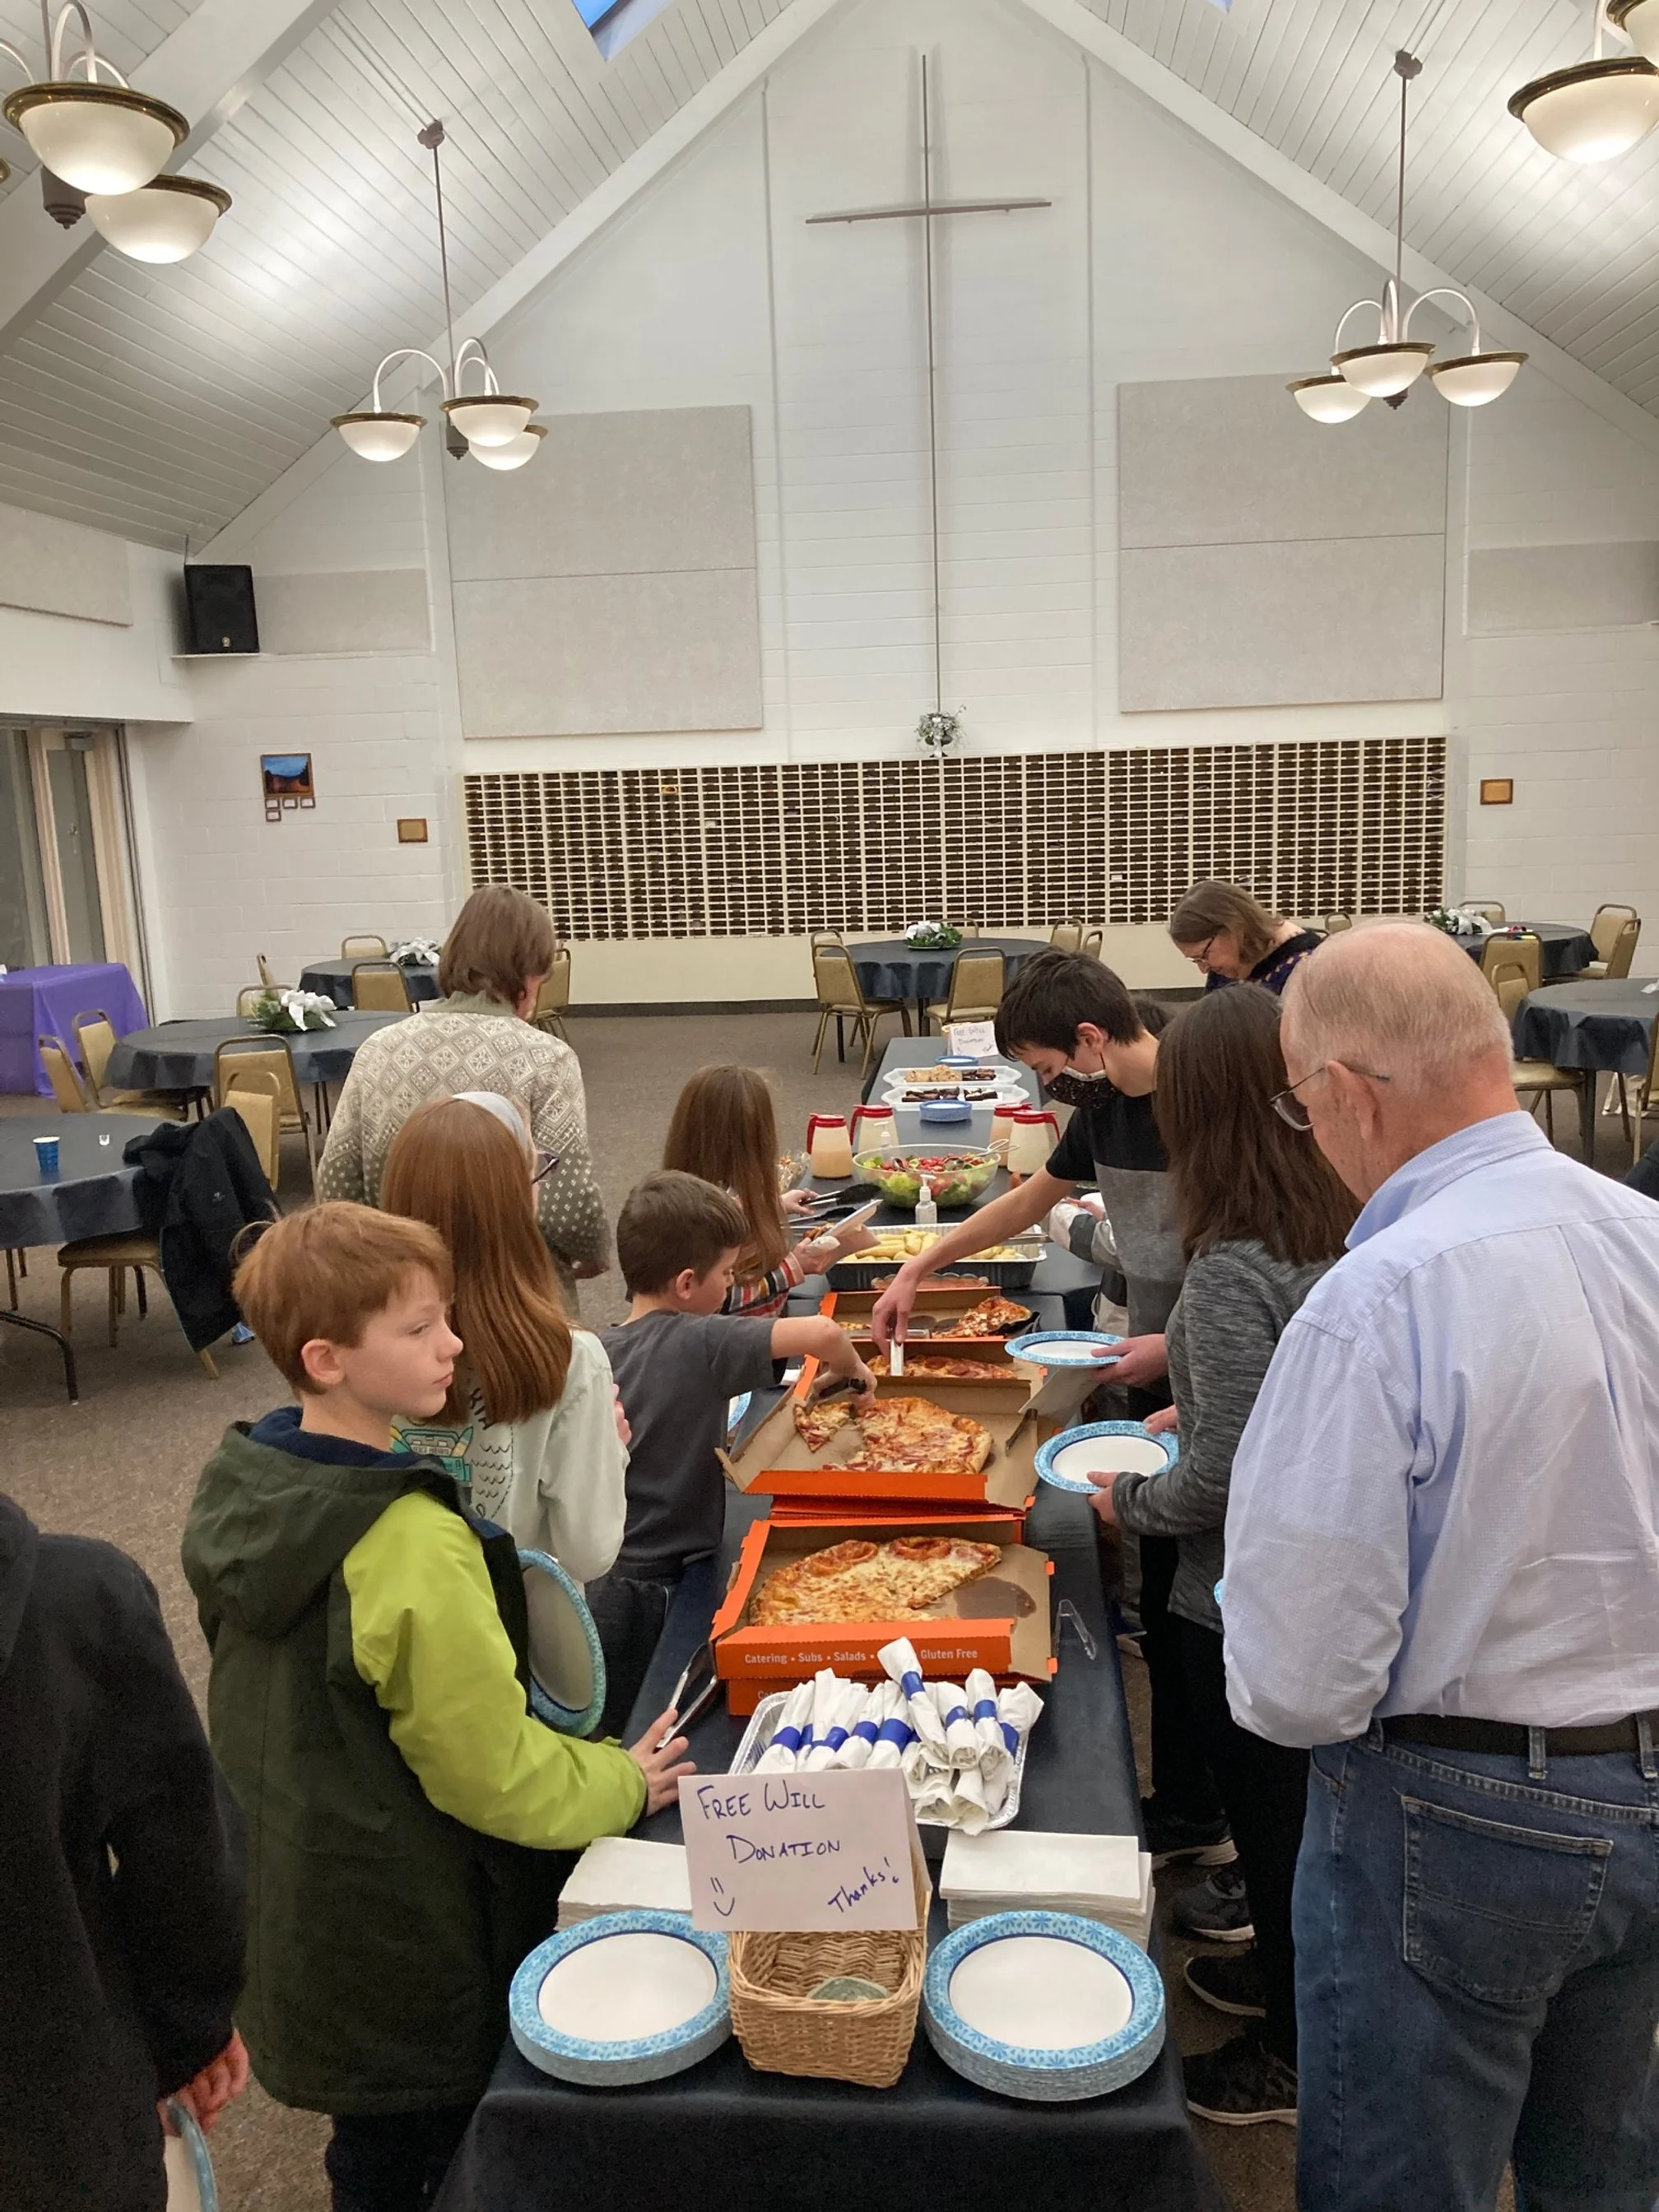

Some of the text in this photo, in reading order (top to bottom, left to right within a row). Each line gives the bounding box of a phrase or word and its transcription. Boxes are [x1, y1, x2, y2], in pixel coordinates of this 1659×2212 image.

[745, 1648, 978, 1665] Catering Subs Salads Gluten Free
[696, 1779, 826, 1820] FREE WILL
[726, 1834, 841, 1864] DONATION
[827, 1856, 899, 1913] Thanks!
